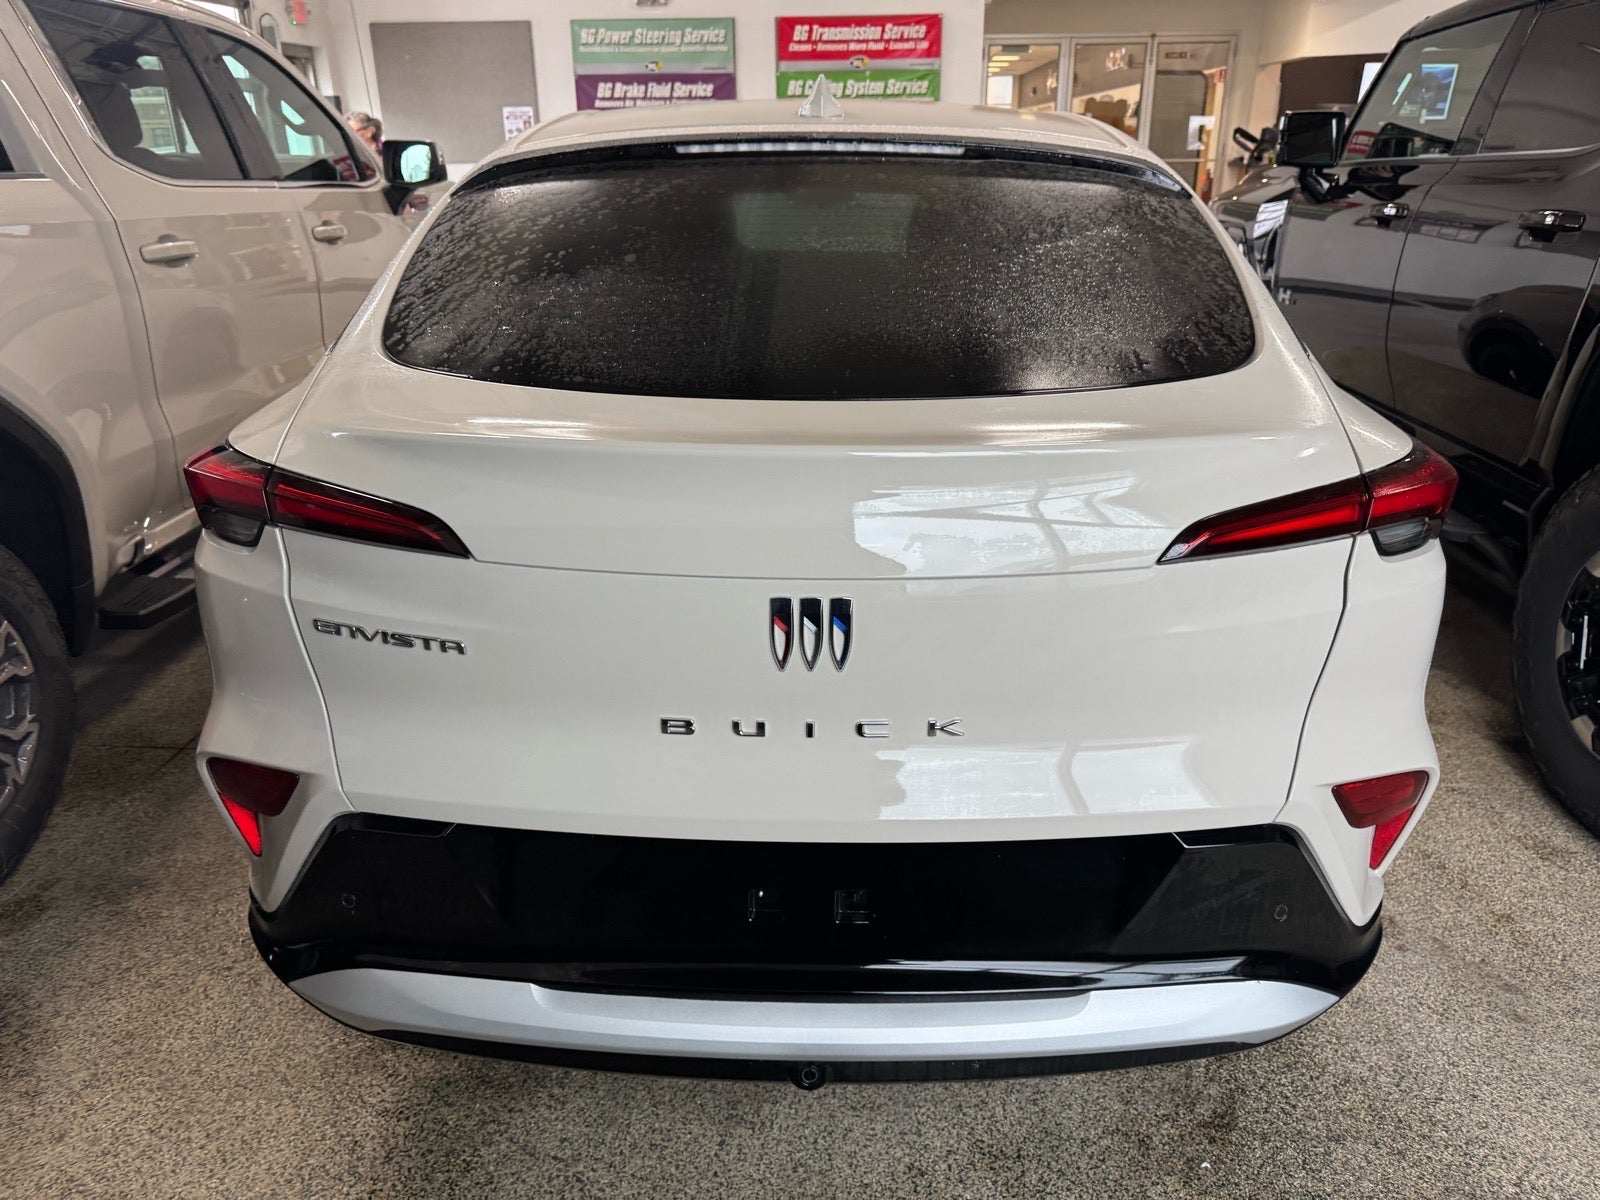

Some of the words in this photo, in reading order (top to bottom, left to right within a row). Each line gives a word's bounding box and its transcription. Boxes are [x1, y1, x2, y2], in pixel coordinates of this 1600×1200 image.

[597, 28, 633, 45] Power
[634, 27, 683, 46] Steering
[683, 27, 726, 44] Service
[811, 24, 882, 41] Transmission
[883, 23, 927, 40] Service
[613, 82, 647, 98] Brake
[646, 81, 672, 98] Fluid
[672, 81, 715, 97] Service
[845, 79, 886, 98] System
[886, 78, 930, 95] Service
[313, 618, 467, 655] ENVISTA
[660, 717, 965, 738] BUICK
